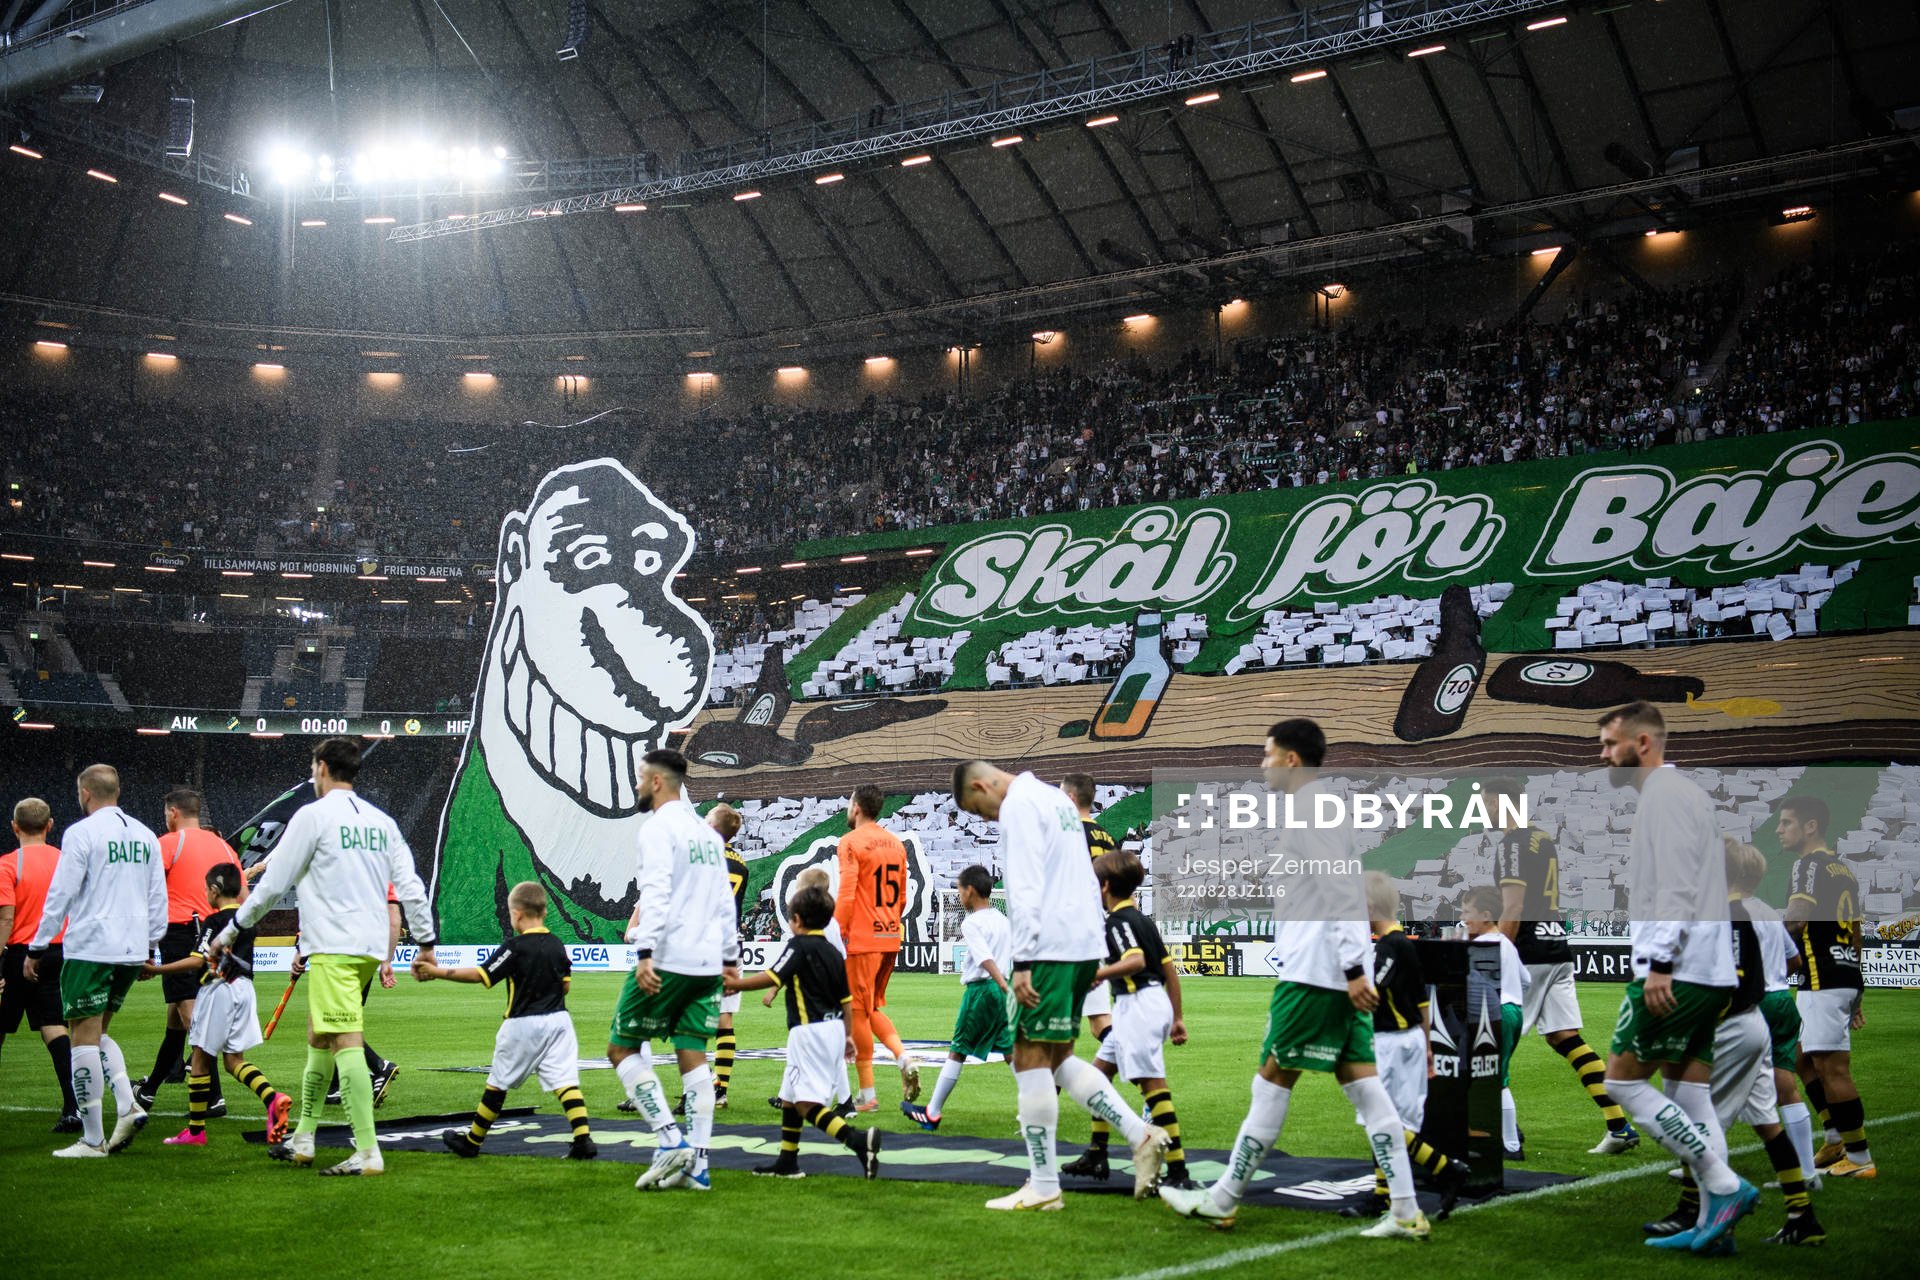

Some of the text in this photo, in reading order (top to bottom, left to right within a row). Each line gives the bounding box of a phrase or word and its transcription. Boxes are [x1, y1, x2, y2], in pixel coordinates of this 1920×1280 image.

[925, 510, 1228, 618] Skål
[1245, 483, 1502, 611] för
[204, 559, 357, 574] TILLSAMMANS MOT MOBBNING
[384, 565, 463, 577] FRIENDS ARENA
[170, 716, 198, 730] AIK
[256, 717, 267, 732] 0
[301, 718, 348, 733] 00:00
[380, 720, 391, 735] 0
[340, 825, 388, 852] BAJEN
[108, 840, 151, 864] BAJEN
[873, 863, 900, 908] 15
[873, 920, 900, 933] SVE
[476, 948, 495, 962] SV
[572, 947, 610, 962] SVEA
[1829, 945, 1859, 962] SVE
[1864, 977, 1920, 986] ASTENHUG
[1435, 1053, 1461, 1078] ECT
[1471, 1053, 1499, 1078] SELECT
